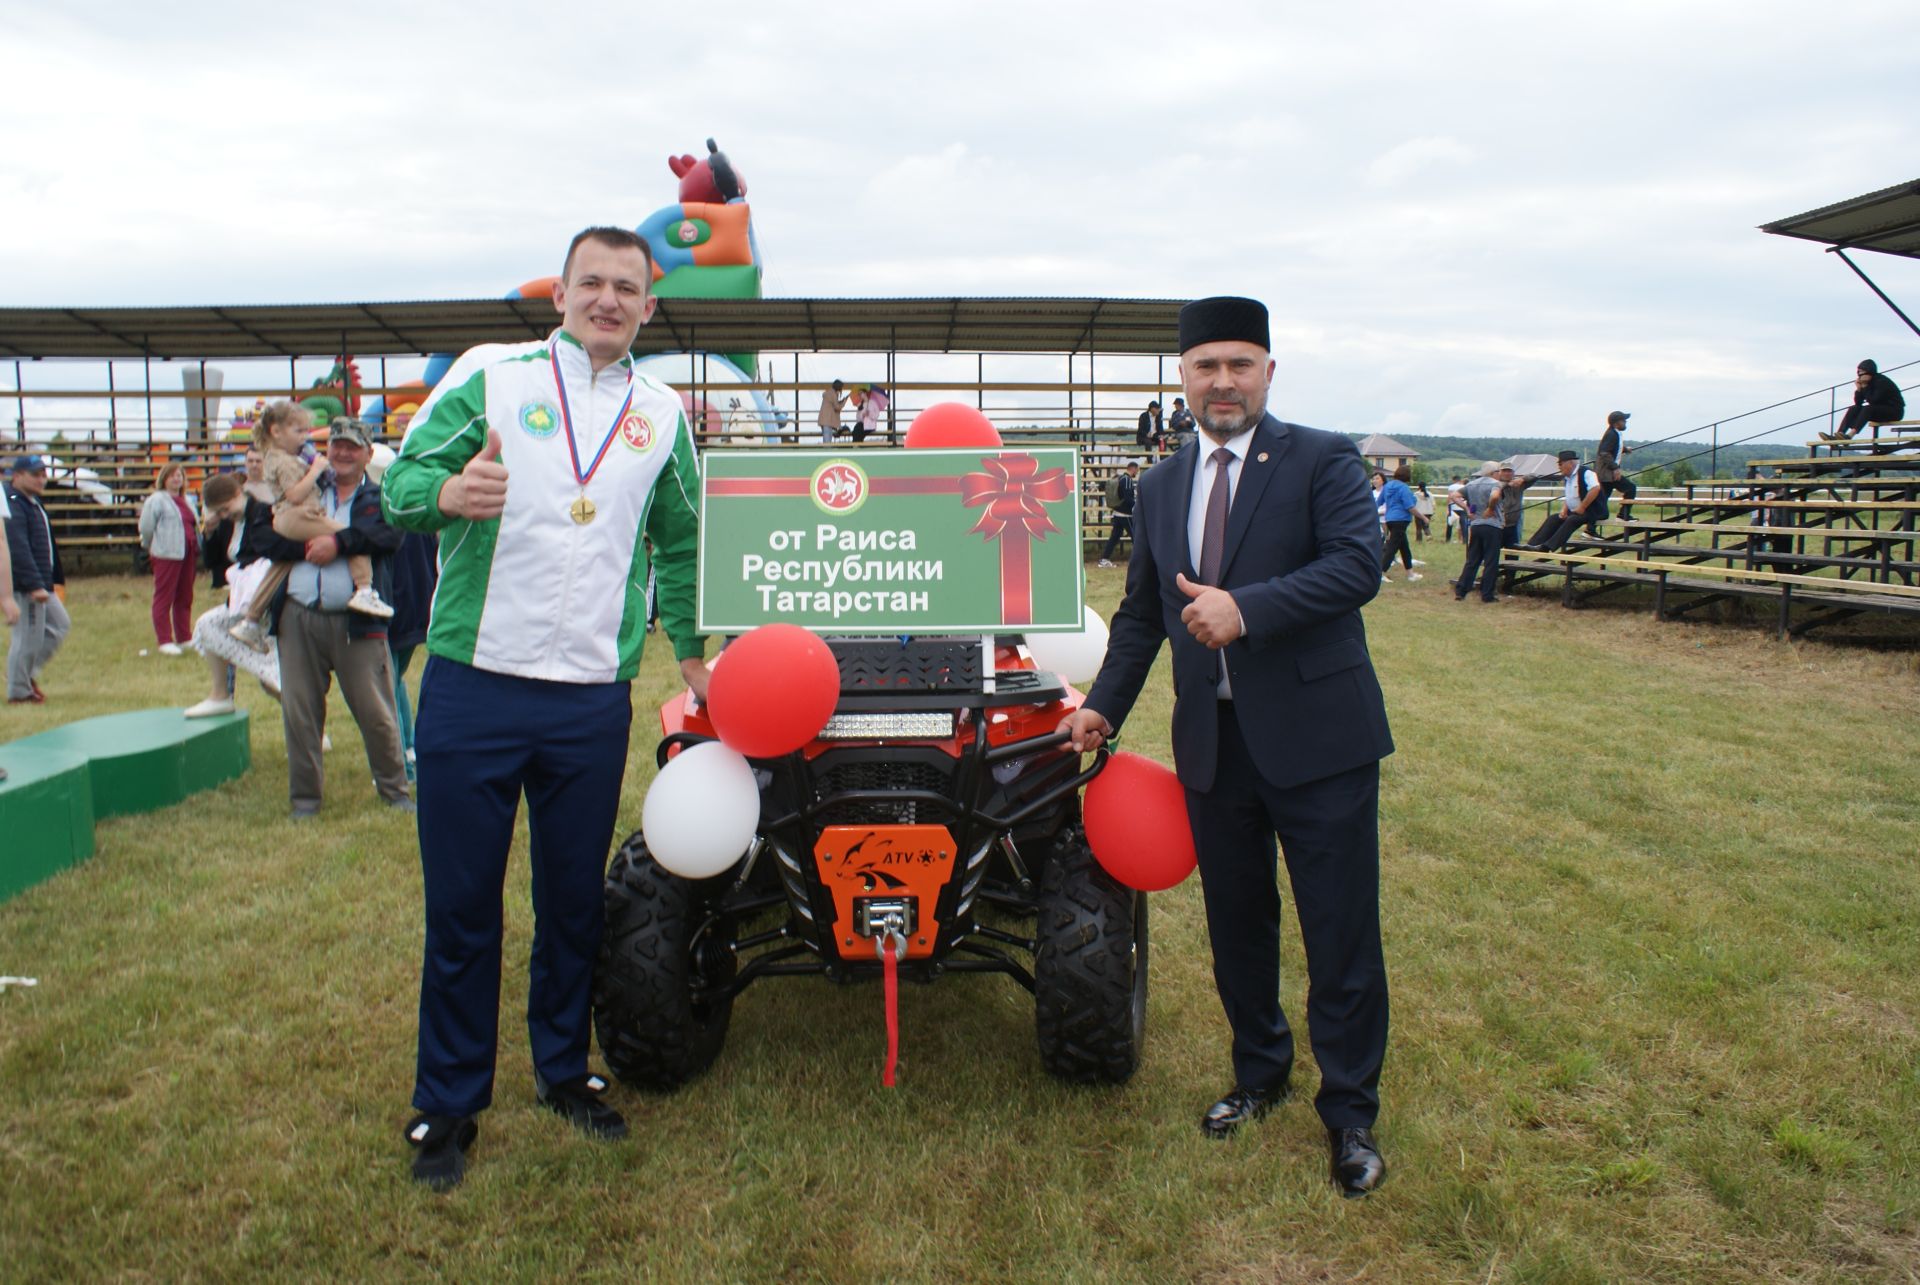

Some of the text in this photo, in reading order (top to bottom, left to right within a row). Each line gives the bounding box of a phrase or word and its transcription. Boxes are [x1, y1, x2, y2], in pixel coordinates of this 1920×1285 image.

[769, 524, 917, 550] от Раиса
[742, 554, 943, 587] Республики
[756, 585, 929, 618] Татарстан
[883, 852, 914, 864] ATV
